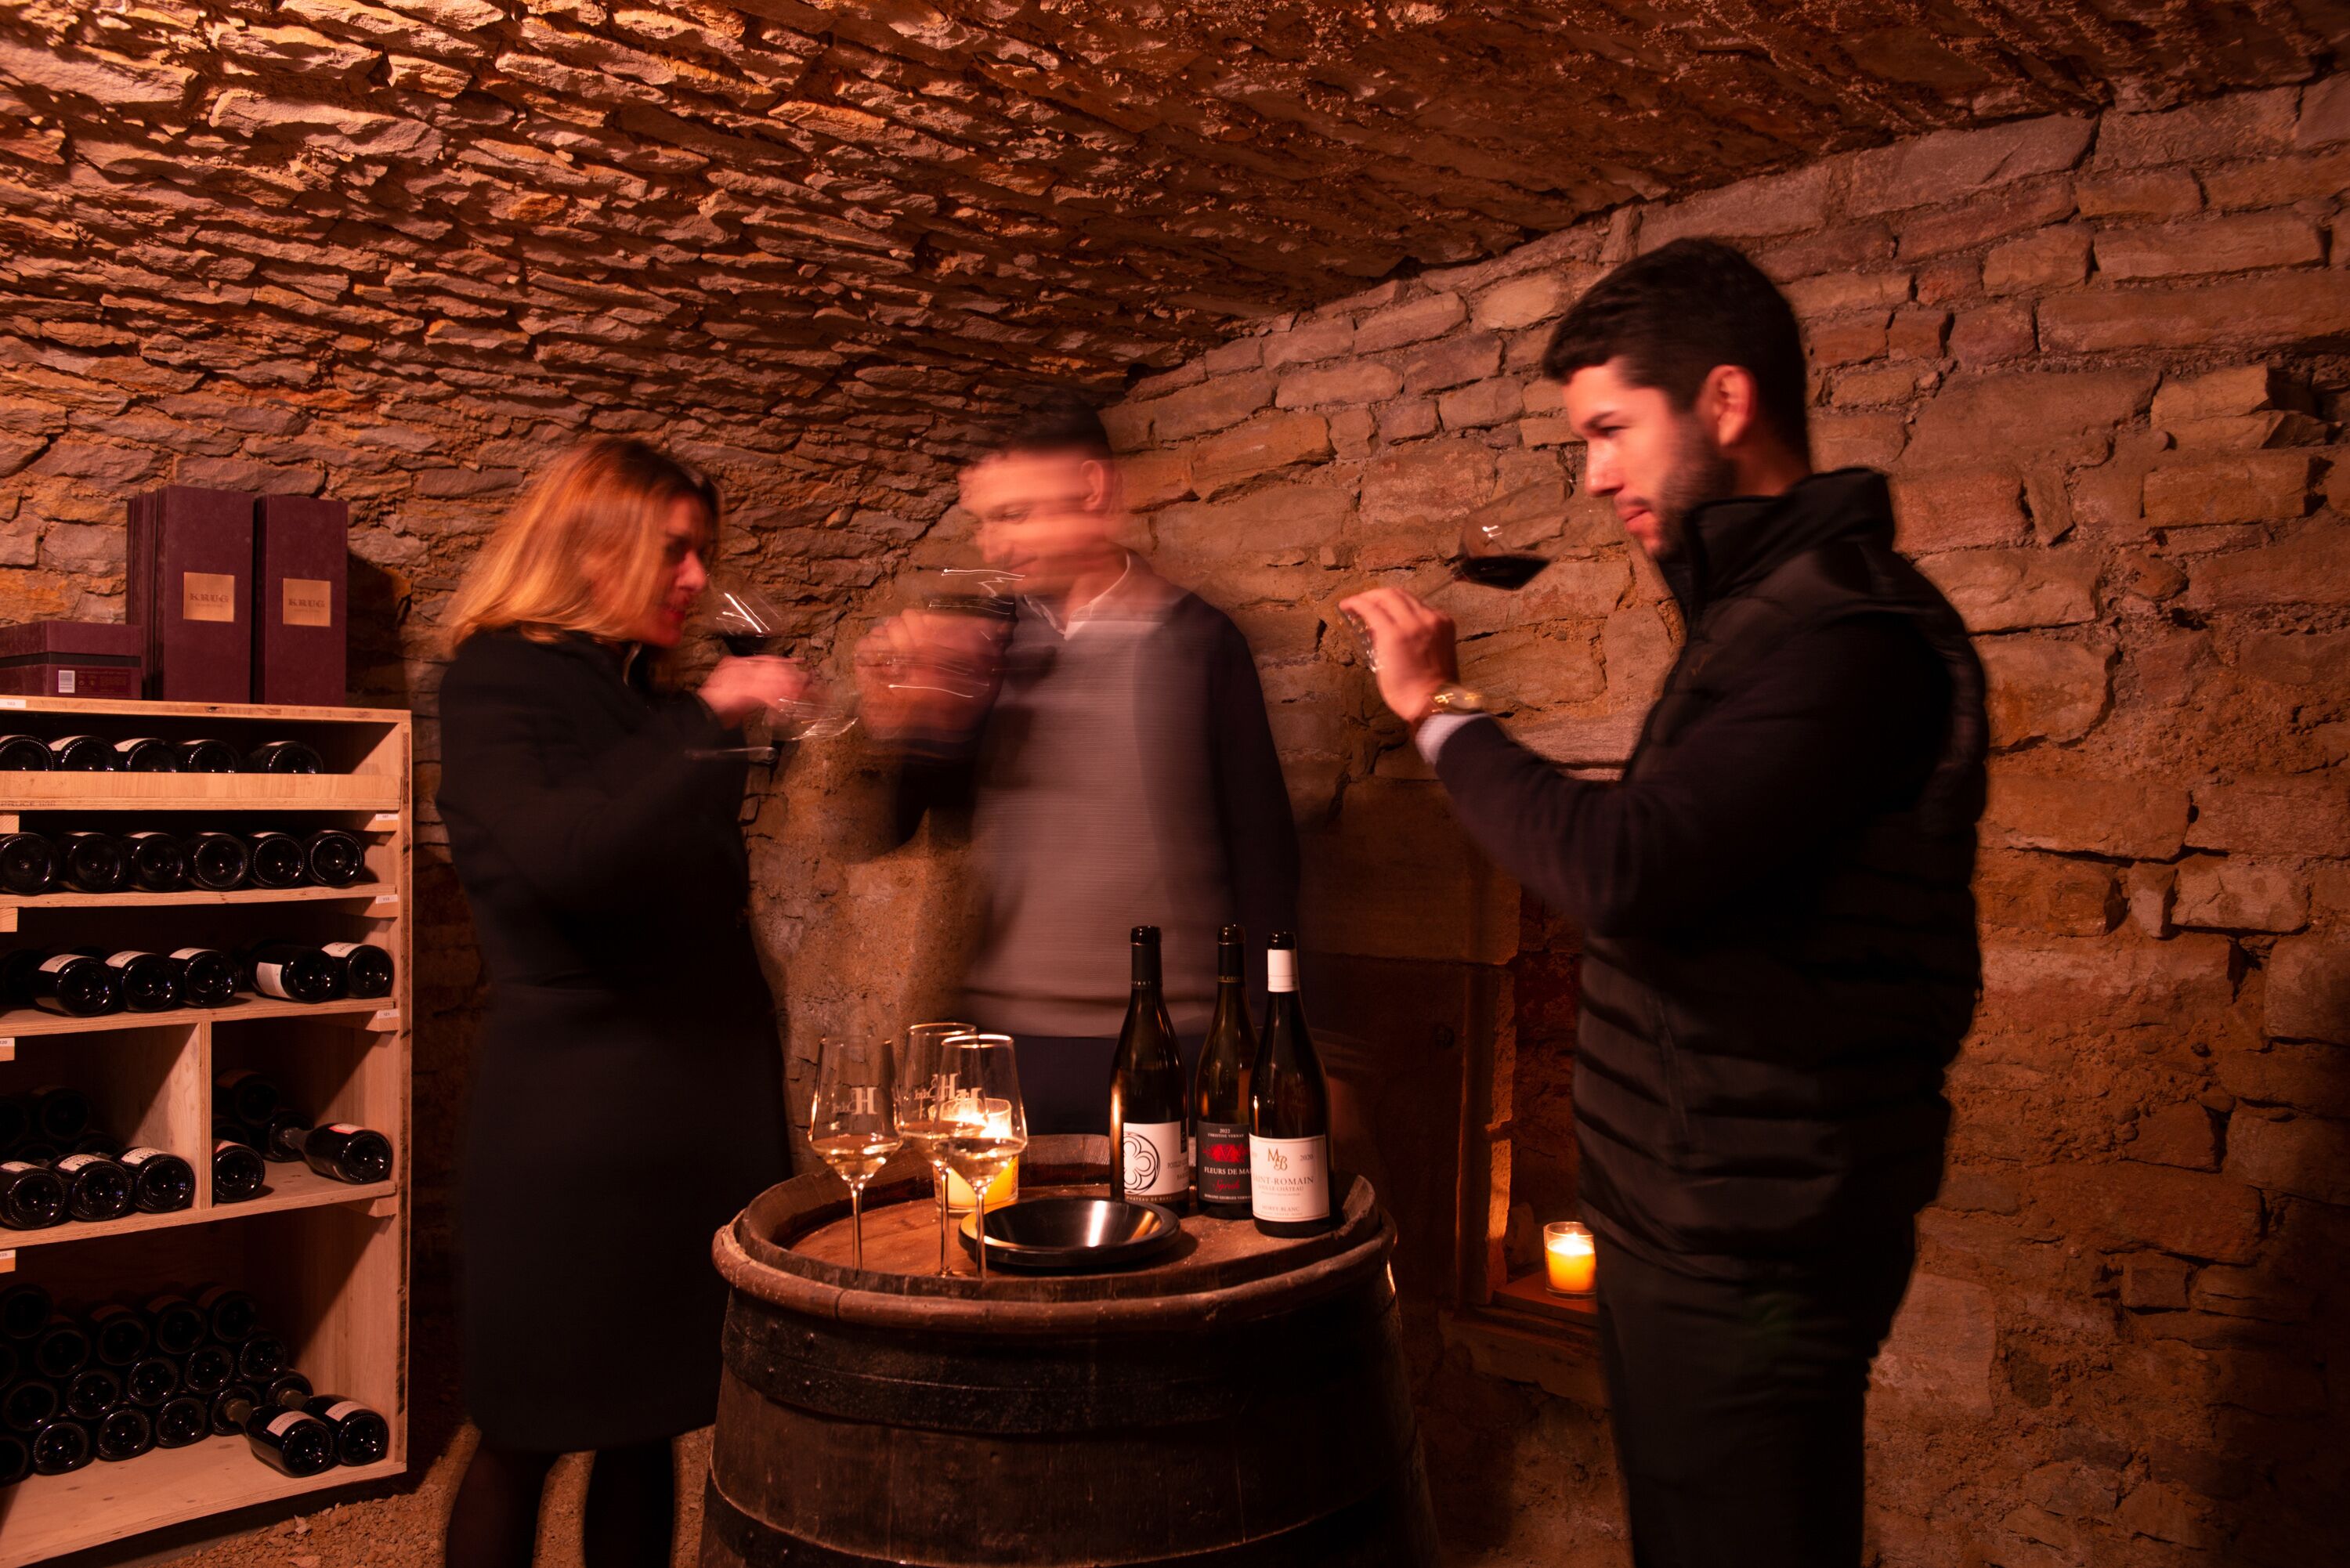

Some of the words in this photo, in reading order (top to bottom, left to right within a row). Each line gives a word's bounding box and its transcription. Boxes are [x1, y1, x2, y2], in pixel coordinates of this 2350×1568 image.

[190, 592, 230, 603] KRUG
[288, 598, 326, 608] KRUG
[1204, 1166, 1226, 1175] FLEURS
